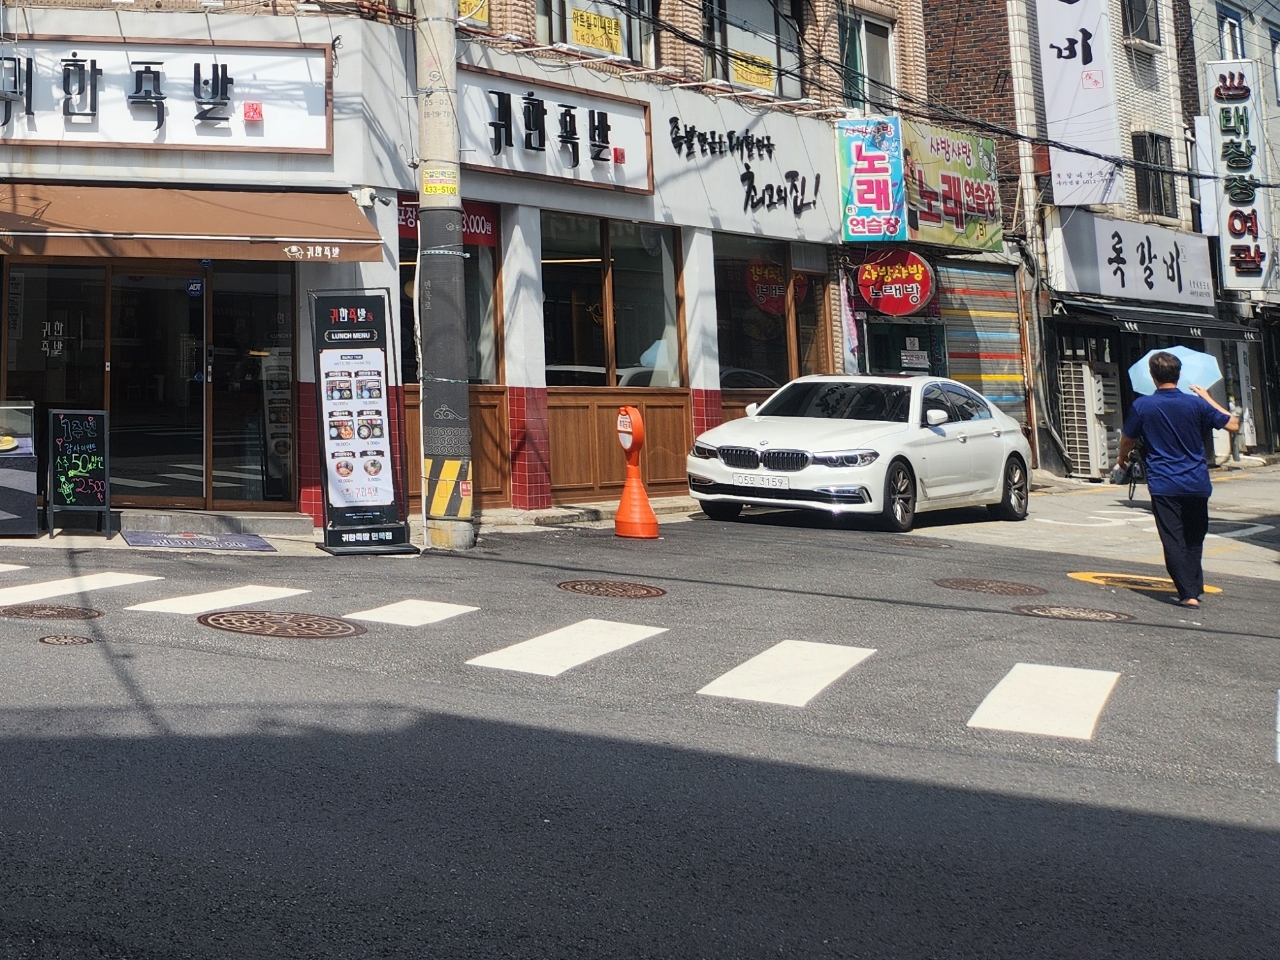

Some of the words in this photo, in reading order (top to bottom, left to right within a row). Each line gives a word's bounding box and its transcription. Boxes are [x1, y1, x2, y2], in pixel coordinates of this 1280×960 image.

[487, 90, 613, 169] 귀한족발
[929, 136, 973, 168] 샤방샤방
[852, 142, 892, 212] 노래
[846, 206, 857, 214] B1
[848, 216, 902, 236] 연습장
[978, 222, 988, 237] B1
[305, 245, 340, 259] 귀한족발
[861, 262, 926, 282] 샤방샤방
[188, 283, 202, 291] ADT
[869, 283, 921, 305] 노래방
[329, 306, 367, 325] 귀한족발
[331, 332, 352, 340] LUNCH
[352, 331, 371, 340] MENU
[60, 419, 97, 441] 1주년
[55, 455, 70, 471] 소주
[759, 476, 784, 487] 3159
[341, 533, 370, 542] 귀한족발
[371, 531, 393, 541] 면목점
